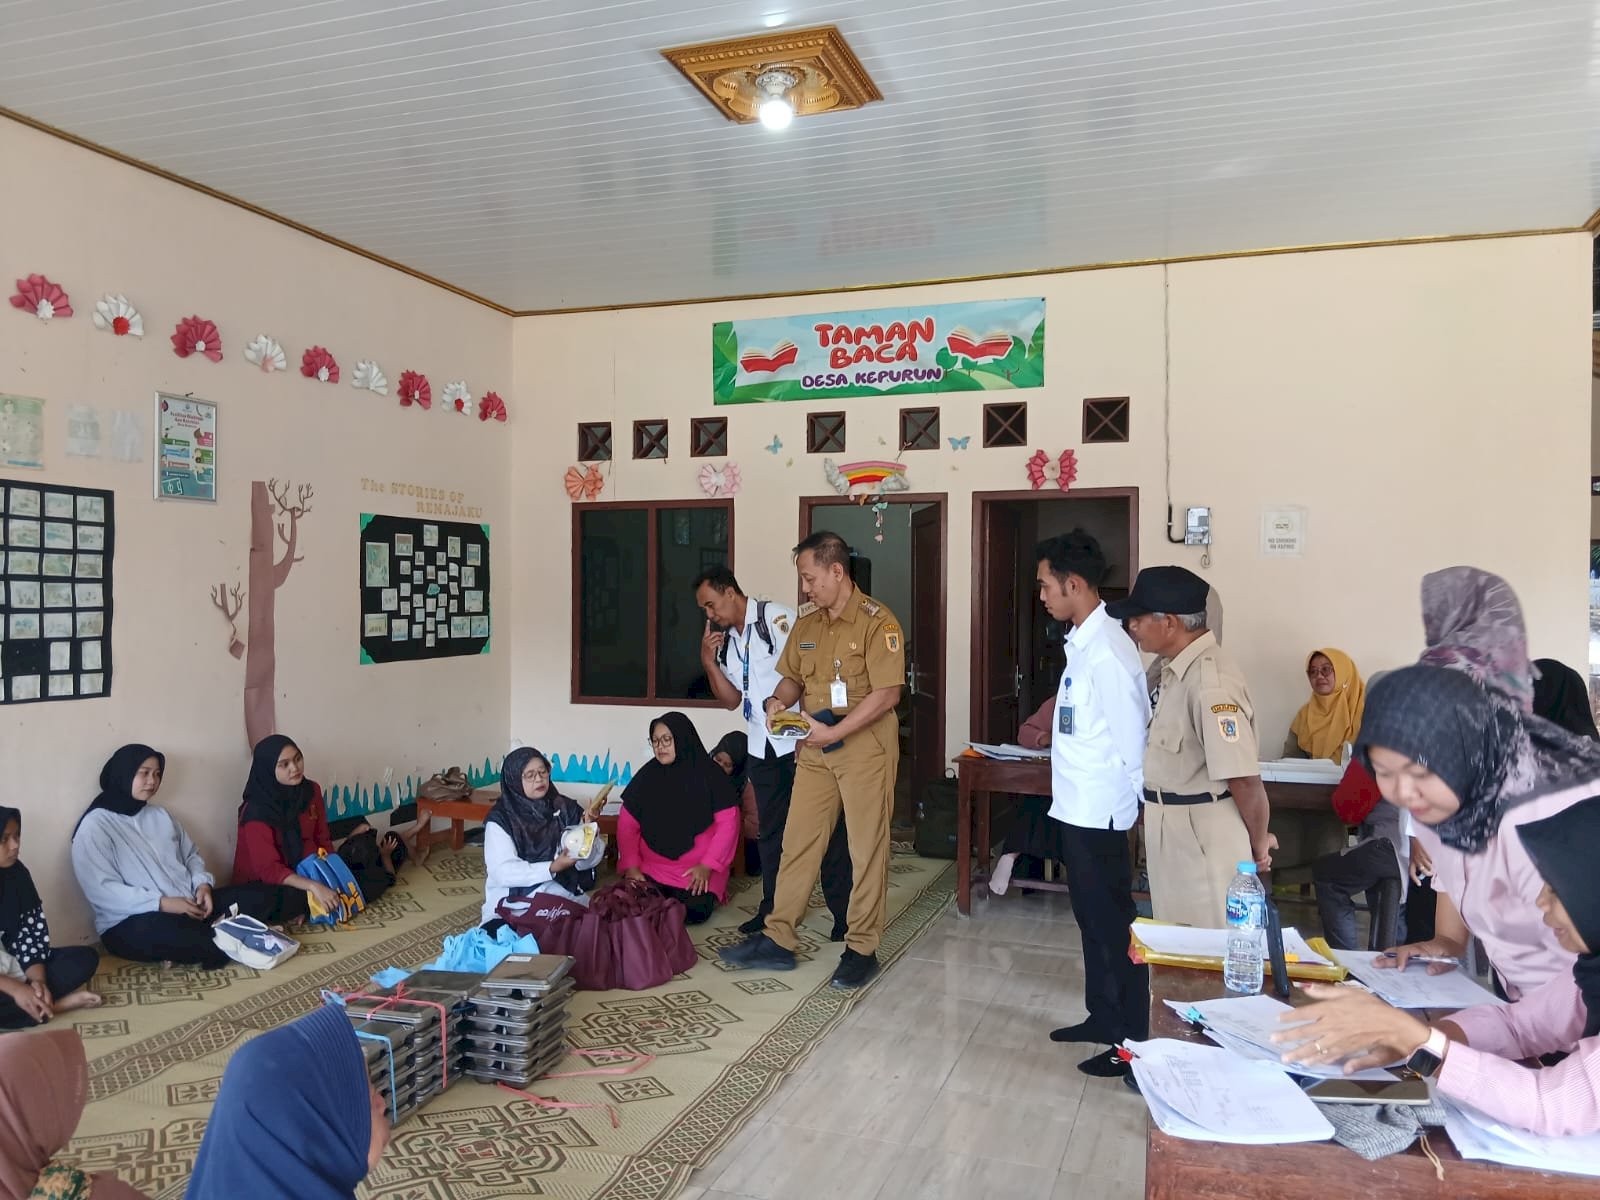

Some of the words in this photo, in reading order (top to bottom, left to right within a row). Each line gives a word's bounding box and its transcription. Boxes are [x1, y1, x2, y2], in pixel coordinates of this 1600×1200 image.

[814, 317, 934, 347] TAMAN
[830, 342, 917, 369] BACA
[802, 373, 848, 388] DESA
[855, 367, 942, 384] KEPURUN
[361, 478, 384, 492] The
[391, 483, 445, 500] STORIES
[450, 491, 464, 503] OF
